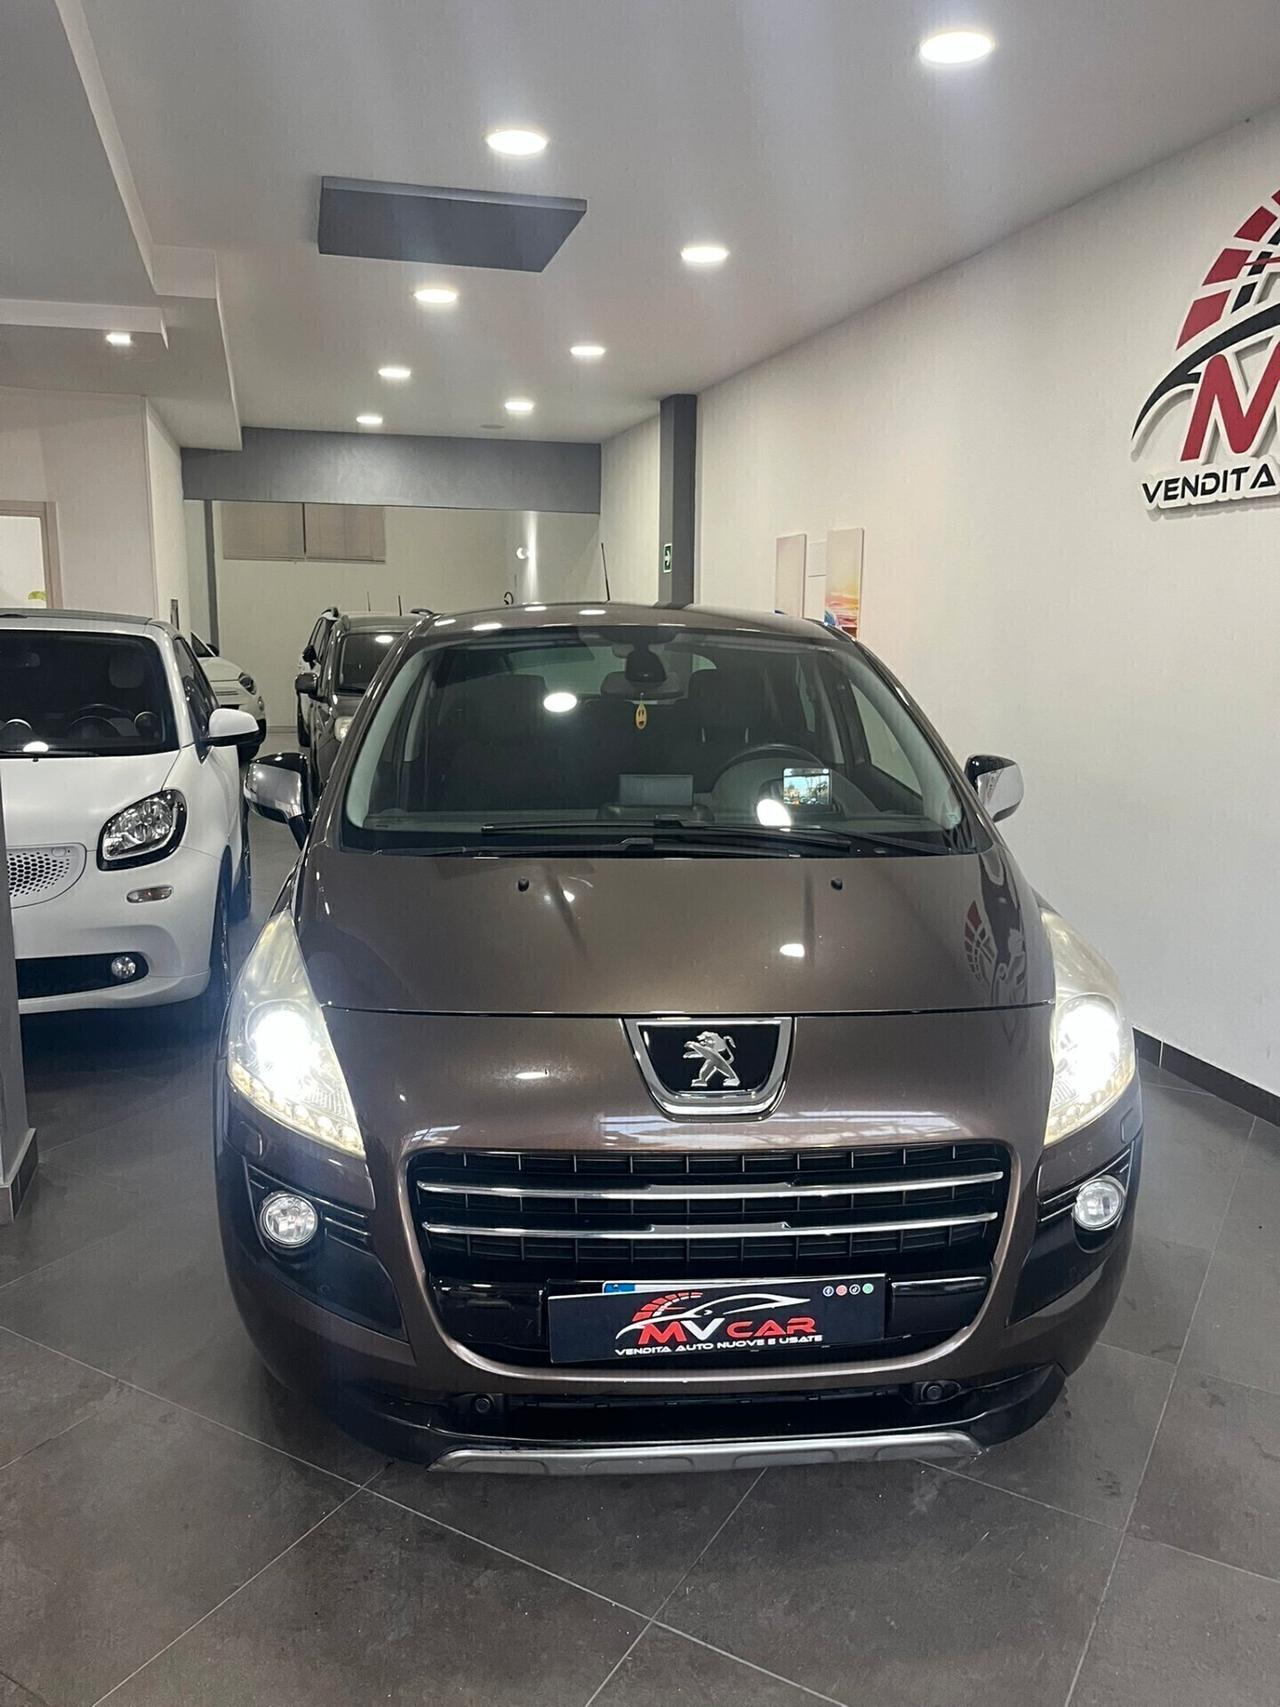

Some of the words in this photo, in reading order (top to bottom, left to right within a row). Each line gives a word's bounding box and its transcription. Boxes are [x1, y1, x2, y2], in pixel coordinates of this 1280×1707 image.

[1142, 463, 1276, 503] VENDITA
[615, 1346, 672, 1356] VENDITA
[675, 1342, 714, 1352] AUTO
[716, 1338, 764, 1349] NUOVE
[767, 1337, 776, 1345] E
[779, 1334, 823, 1344] USATE
